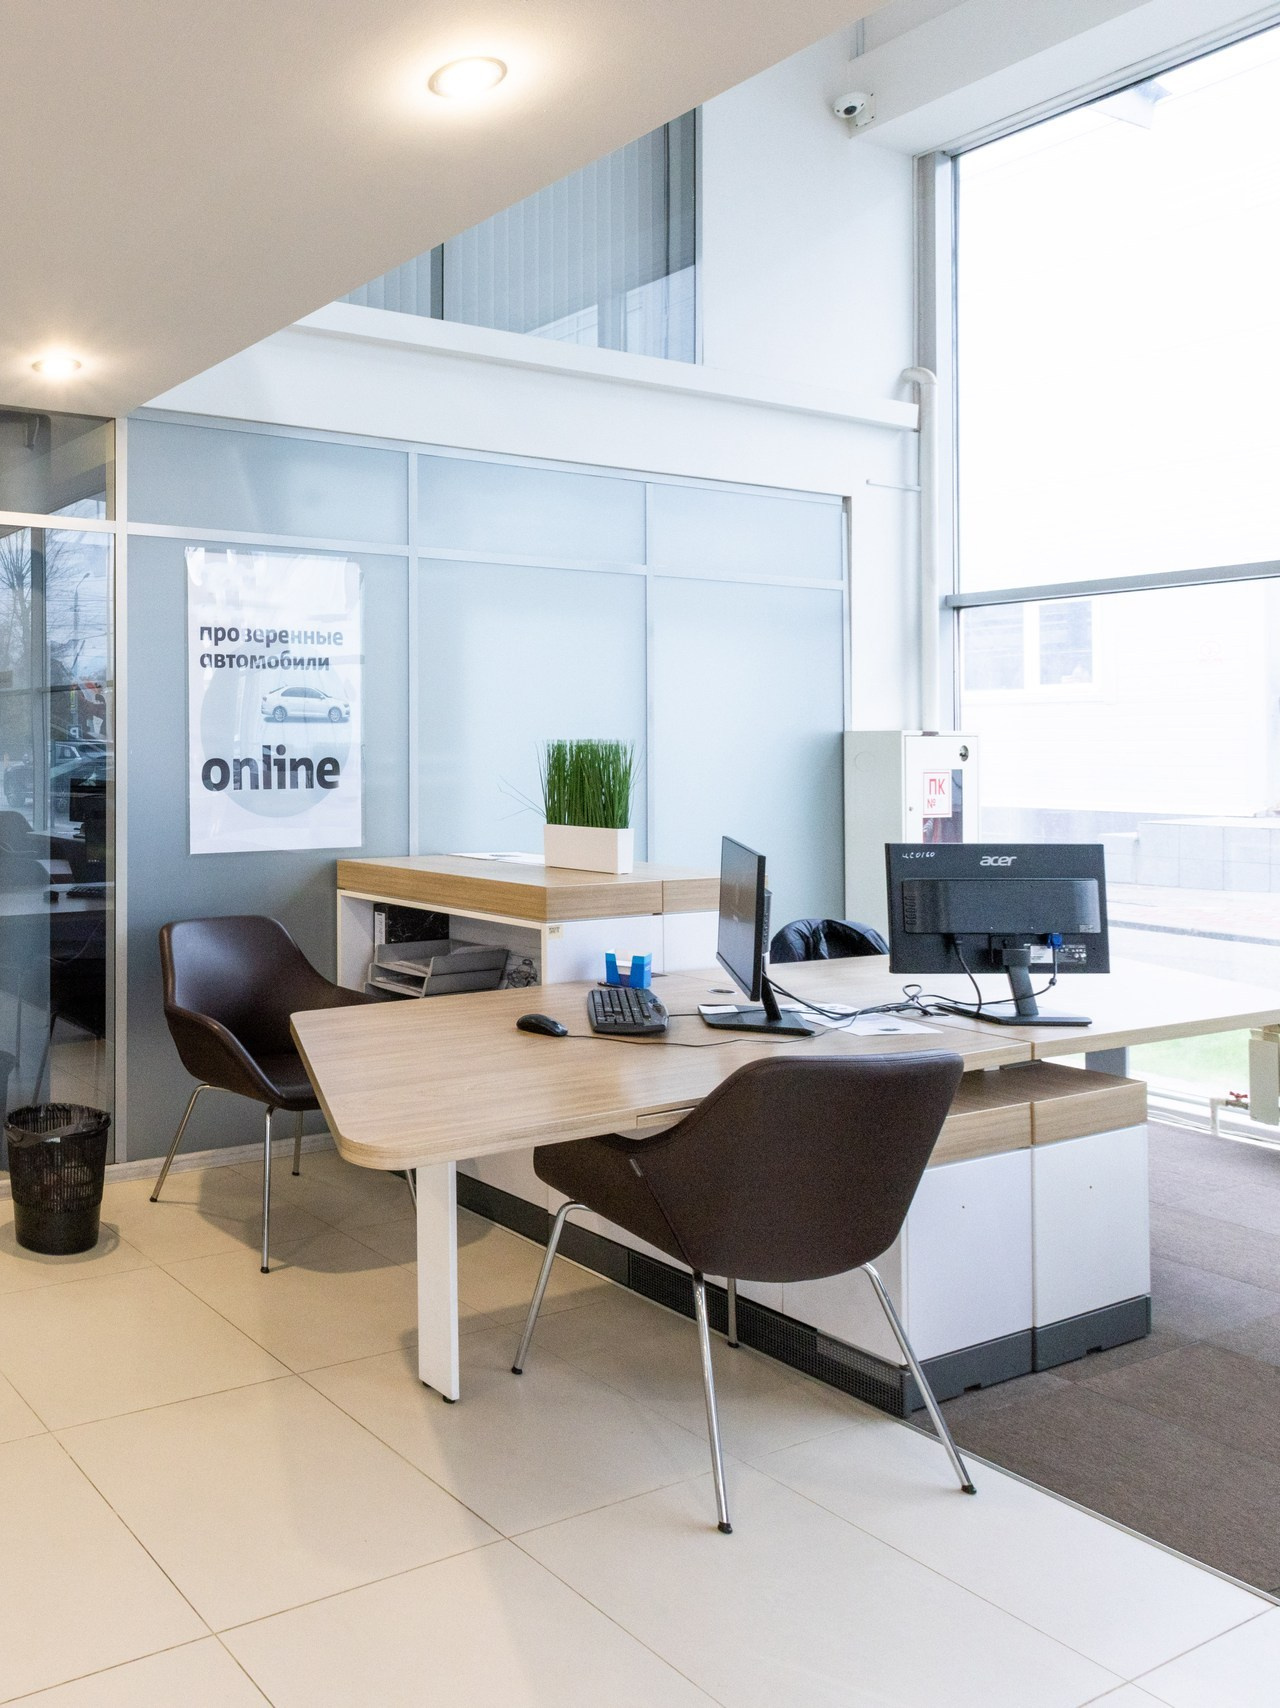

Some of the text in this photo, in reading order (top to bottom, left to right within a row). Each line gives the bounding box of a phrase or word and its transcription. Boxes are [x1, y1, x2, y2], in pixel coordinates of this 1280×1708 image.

[200, 650, 330, 671] автомобили
[201, 744, 341, 792] online
[929, 778, 945, 795] ПК
[980, 856, 1017, 866] acer
